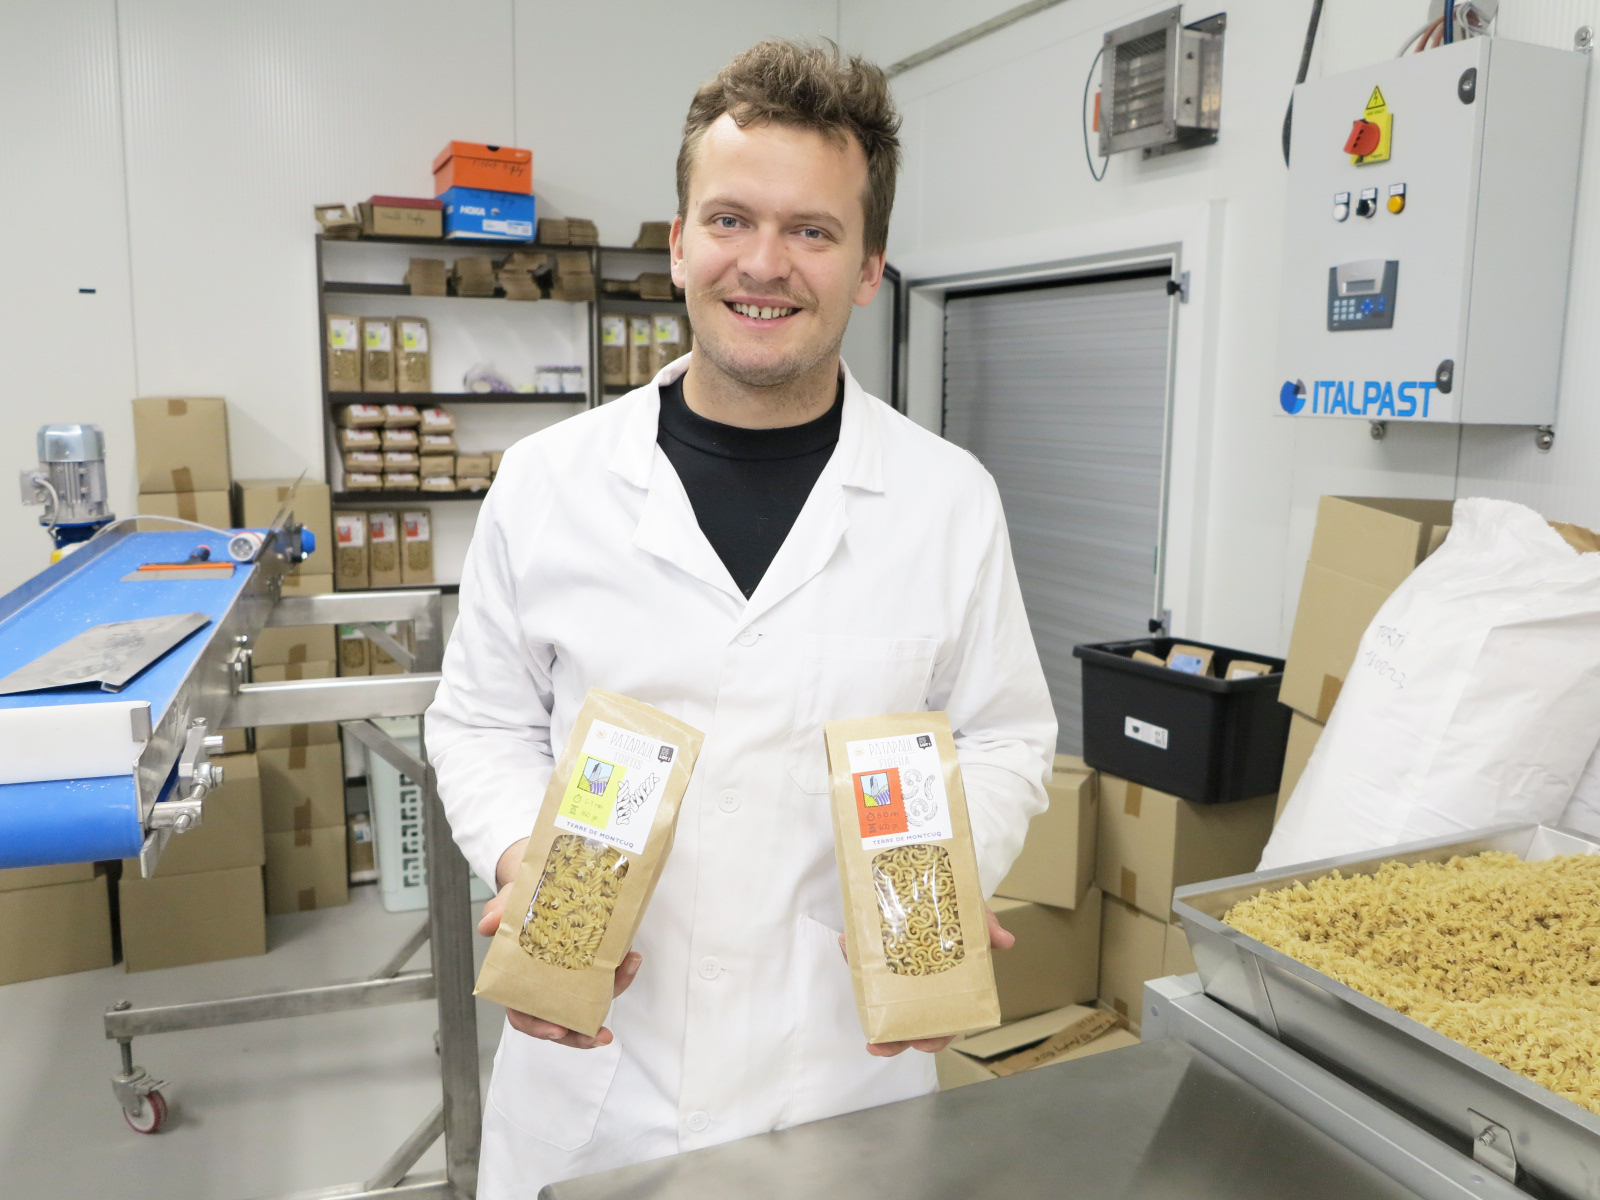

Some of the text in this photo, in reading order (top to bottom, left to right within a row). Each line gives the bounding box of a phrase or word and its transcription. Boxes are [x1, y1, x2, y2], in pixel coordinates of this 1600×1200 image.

[459, 205, 486, 216] HOKA
[1312, 380, 1438, 418] ITALPAST
[609, 731, 655, 760] PATAPAUL
[868, 738, 915, 757] PATAPAUL
[613, 751, 643, 770] TORTIS
[879, 756, 911, 769] FIDEUA
[566, 821, 634, 849] TERRE DE MONTCUQ
[872, 837, 894, 846] TERRE
[906, 831, 942, 841] MONTCUQ
